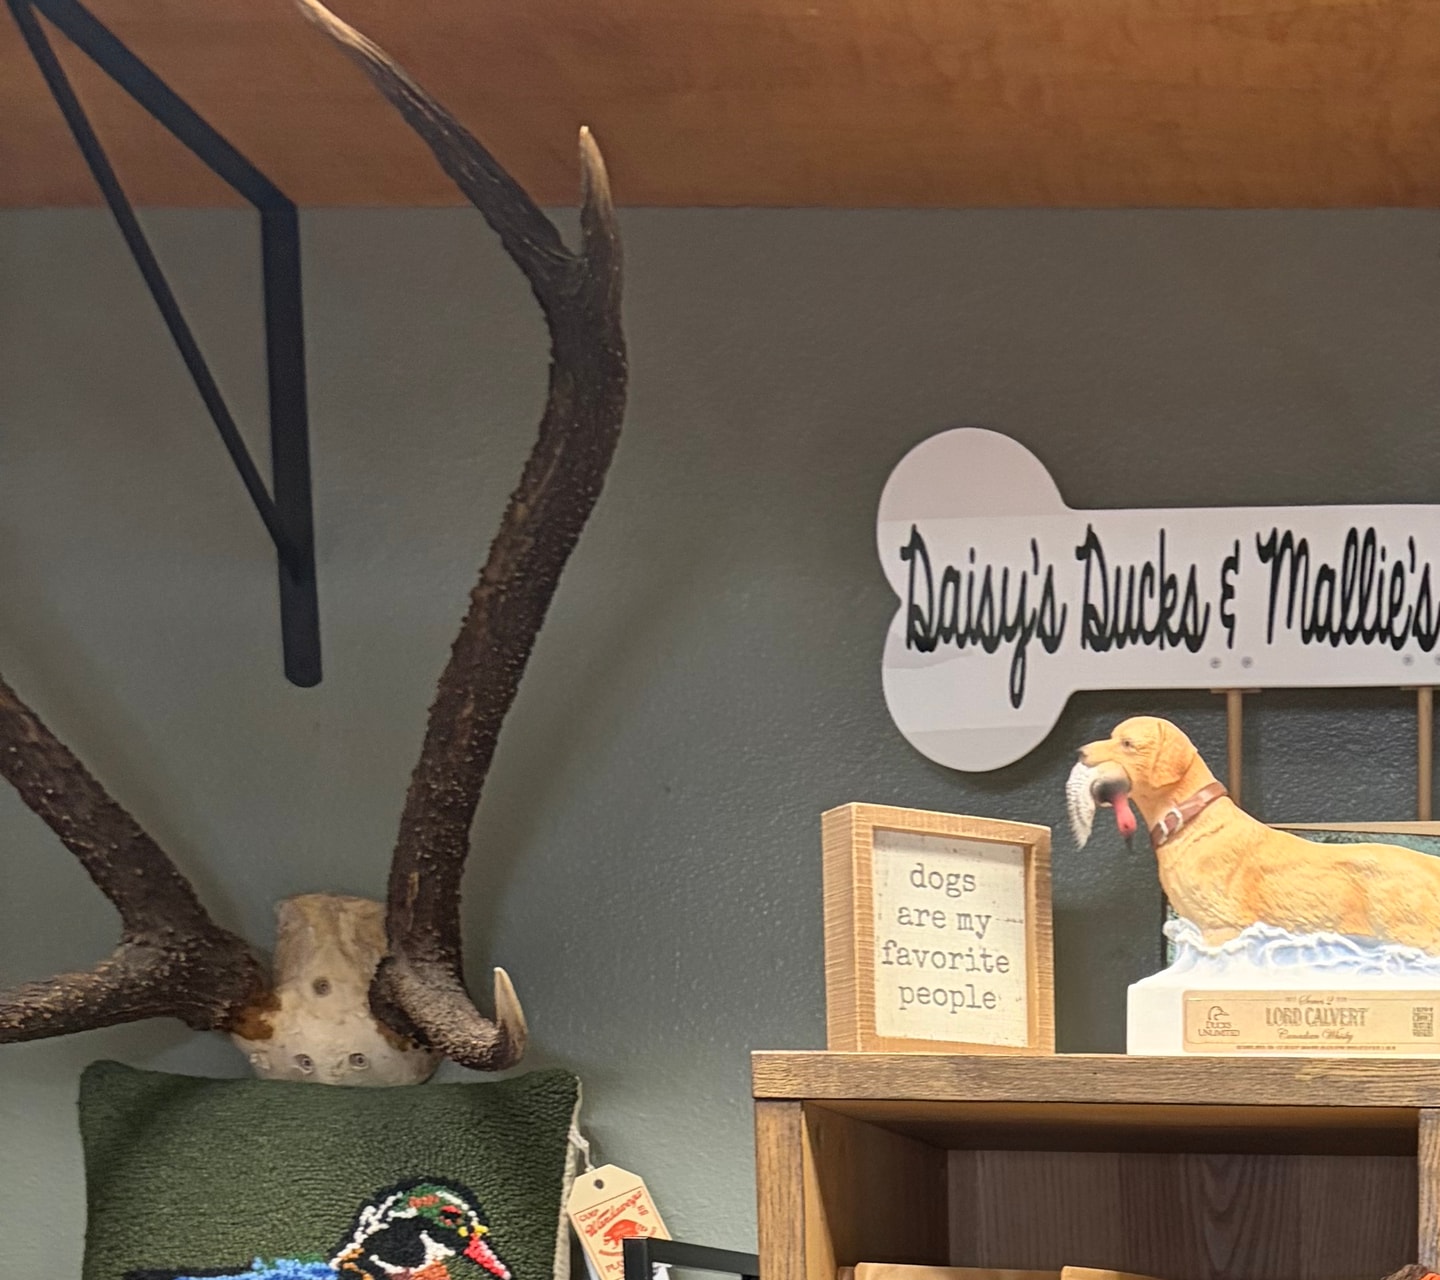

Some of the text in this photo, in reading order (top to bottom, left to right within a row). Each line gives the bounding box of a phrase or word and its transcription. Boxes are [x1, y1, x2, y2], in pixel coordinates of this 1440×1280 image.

[900, 524, 1066, 709] Daisy's
[1075, 524, 1209, 654] Ducks
[1219, 539, 1240, 649] &
[909, 863, 977, 898] dogs
[897, 906, 992, 940] are my
[881, 939, 1011, 974] favorite
[898, 984, 998, 1014] people
[1304, 1007, 1370, 1027] CALVERT
